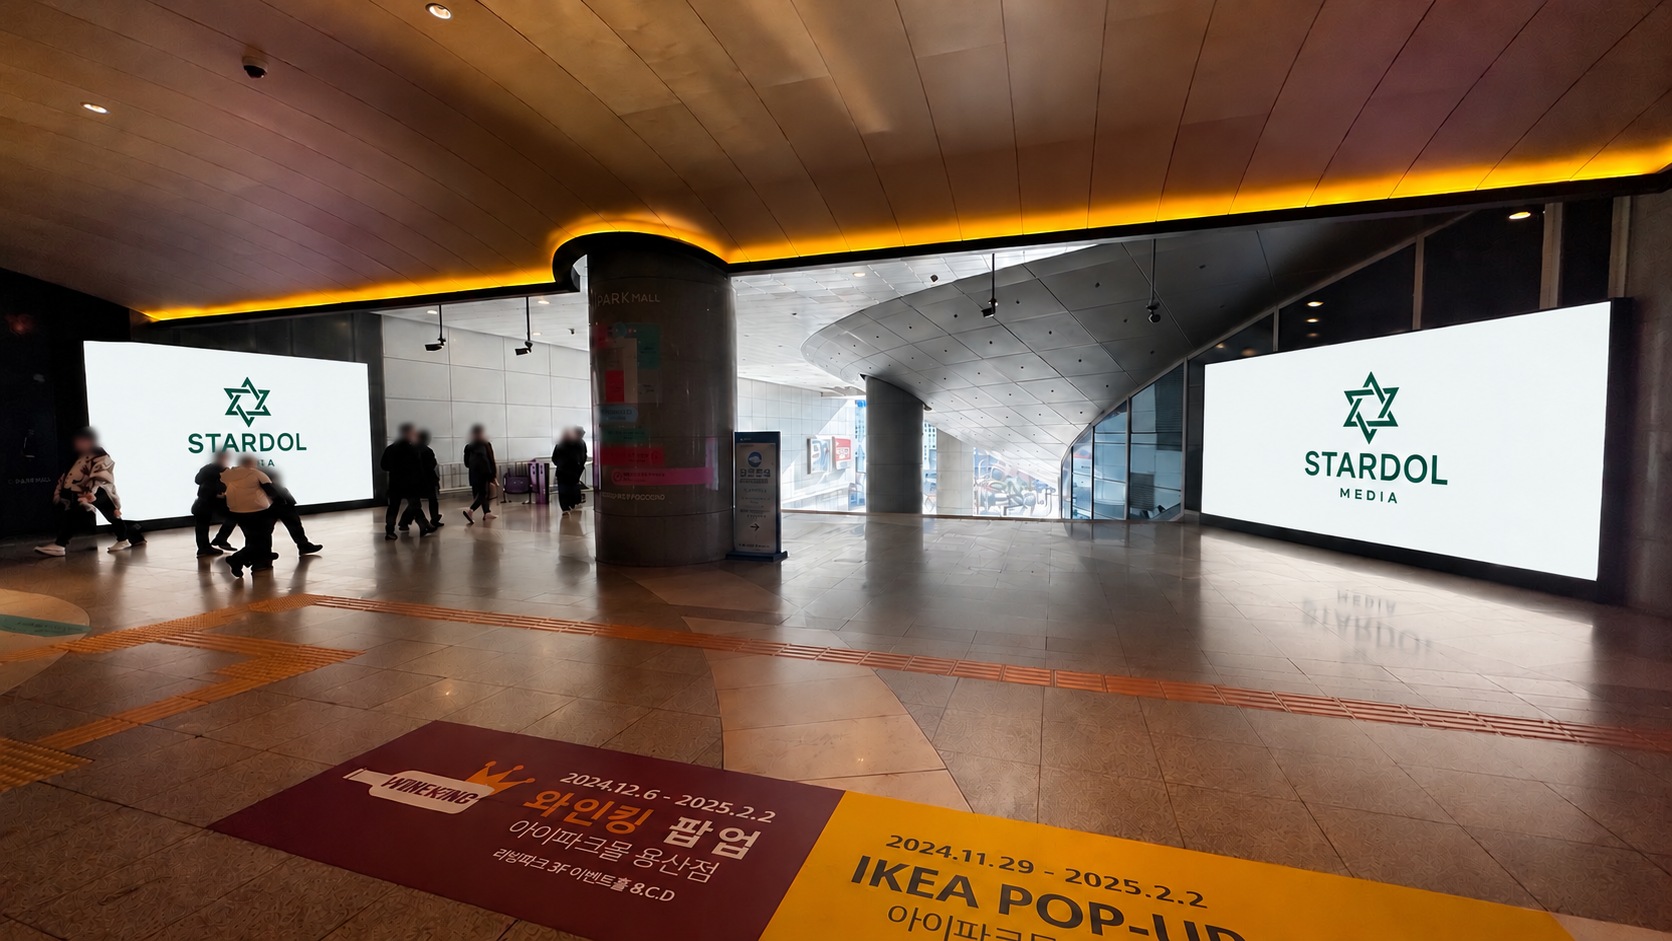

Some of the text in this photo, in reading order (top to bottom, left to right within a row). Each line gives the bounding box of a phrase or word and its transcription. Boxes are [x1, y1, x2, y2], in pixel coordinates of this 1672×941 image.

[631, 293, 661, 303] MALL
[188, 433, 307, 454] STARDOL
[1304, 451, 1448, 486] STARDOL
[1340, 488, 1398, 504] MEDIA
[381, 776, 479, 804] WINEKING
[560, 772, 661, 801] 2024.12.6
[674, 794, 776, 824] 2025.2.2
[522, 790, 762, 860] 와인킹 팝업
[492, 848, 550, 871] 리빙파크
[547, 861, 571, 875] 3F
[569, 867, 632, 892] 이벤트홀
[508, 820, 720, 883] 아이파크몰 용산점
[886, 834, 1034, 874] 2024.11.29
[1065, 868, 1208, 909] 2025.2.2
[851, 855, 979, 909] IKEA
